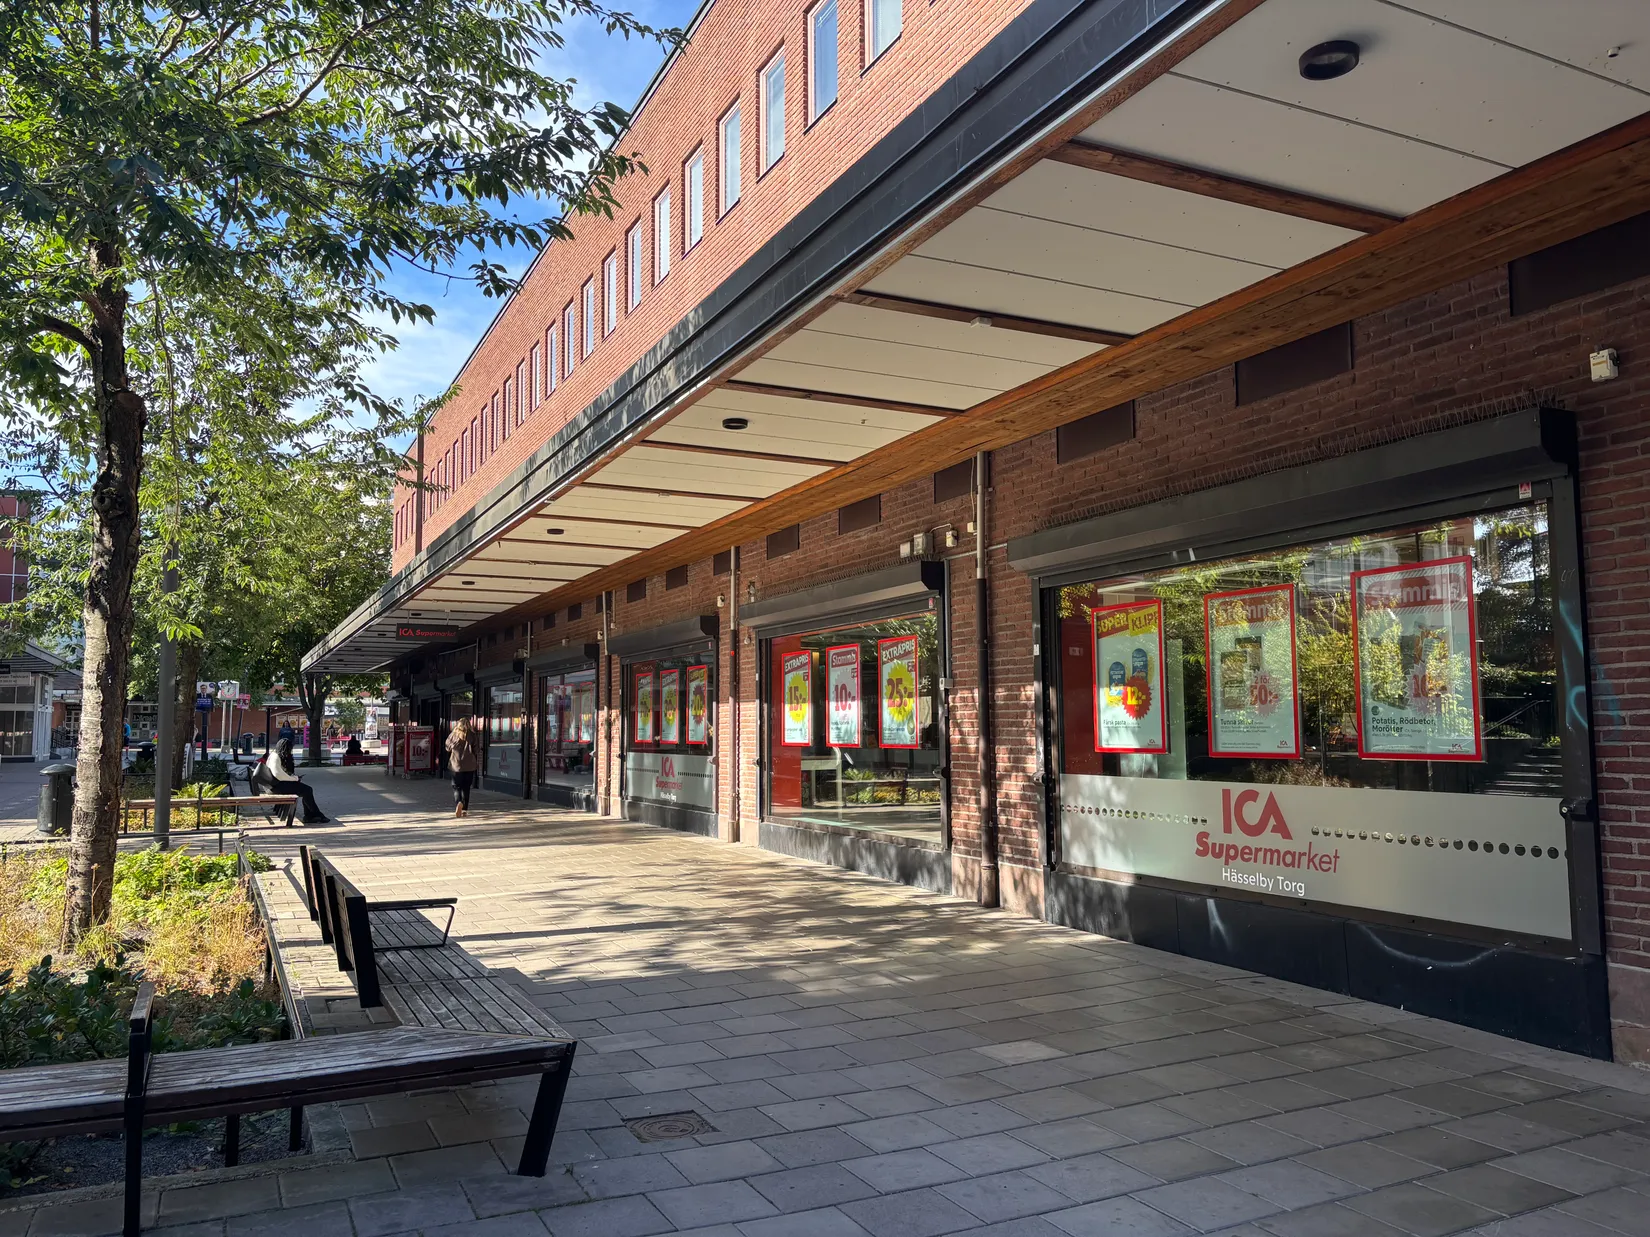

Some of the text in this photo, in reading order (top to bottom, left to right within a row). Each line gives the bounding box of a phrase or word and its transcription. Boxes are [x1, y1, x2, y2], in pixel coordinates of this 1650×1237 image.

[399, 628, 456, 637] ICA Supermarket
[882, 639, 915, 661] EXTRAPRIS
[784, 654, 808, 672] EXTRAPRIS
[1254, 675, 1270, 684] 2 för
[788, 686, 806, 712] 15:-
[834, 683, 856, 712] 10:-
[887, 678, 914, 708] 25:-
[1126, 686, 1146, 706] 12:-
[1250, 684, 1279, 706] 50:-
[1372, 717, 1398, 726] Potatis,
[412, 746, 428, 756] 10:-
[662, 756, 675, 778] ICA
[1222, 788, 1294, 840] ICA
[1195, 831, 1340, 874] Supermarket
[1222, 868, 1305, 896] Hässelby Torg
